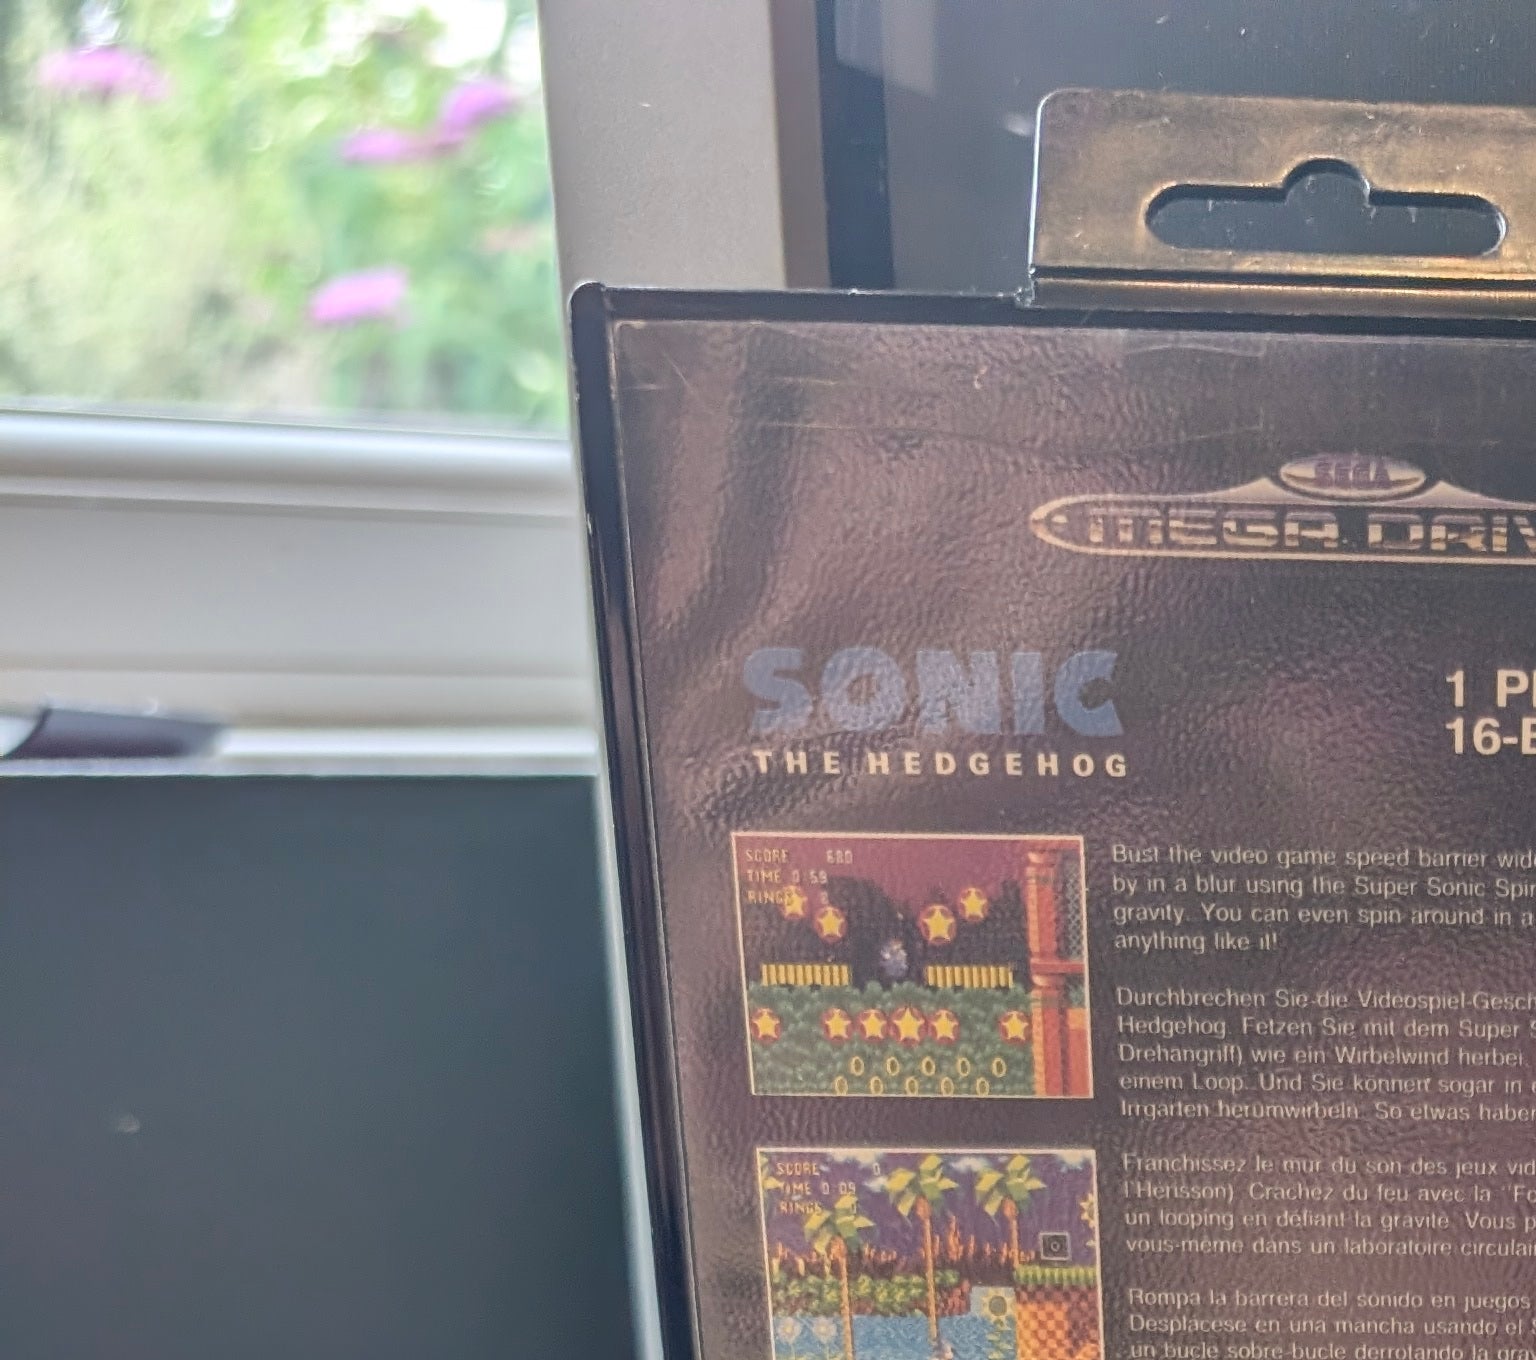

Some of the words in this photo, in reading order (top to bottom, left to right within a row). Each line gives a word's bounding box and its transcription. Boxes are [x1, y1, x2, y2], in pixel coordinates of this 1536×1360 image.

[1314, 459, 1392, 488] SEGA
[1087, 507, 1340, 550] MEGA
[743, 647, 1124, 737] SONIC
[1445, 670, 1466, 708] 1
[753, 749, 841, 776] THE
[868, 750, 1128, 778] HEDGEHOG
[745, 848, 789, 863] SCORE
[1112, 844, 1158, 863] Bust
[1169, 843, 1201, 864] the
[1211, 844, 1268, 865] video
[1277, 850, 1335, 869] game
[1346, 847, 1409, 870] speed
[1418, 846, 1487, 867] barrier
[746, 868, 782, 883] TIME
[1113, 873, 1137, 897] by
[1148, 878, 1165, 892] in
[1175, 877, 1187, 892] a
[1196, 874, 1235, 893] blur
[1246, 878, 1303, 899] using
[1313, 876, 1345, 894] the
[1355, 876, 1417, 899] Super
[1428, 877, 1485, 897] Sonic
[1201, 902, 1242, 922] You
[1251, 907, 1288, 923] can
[1298, 908, 1348, 924] even
[1358, 908, 1402, 928] spin
[1411, 907, 1483, 925] around
[1494, 911, 1511, 925] in
[1521, 910, 1533, 927] a
[1115, 930, 1205, 955] anything
[1215, 931, 1250, 950] like
[776, 1162, 820, 1176] SCORE
